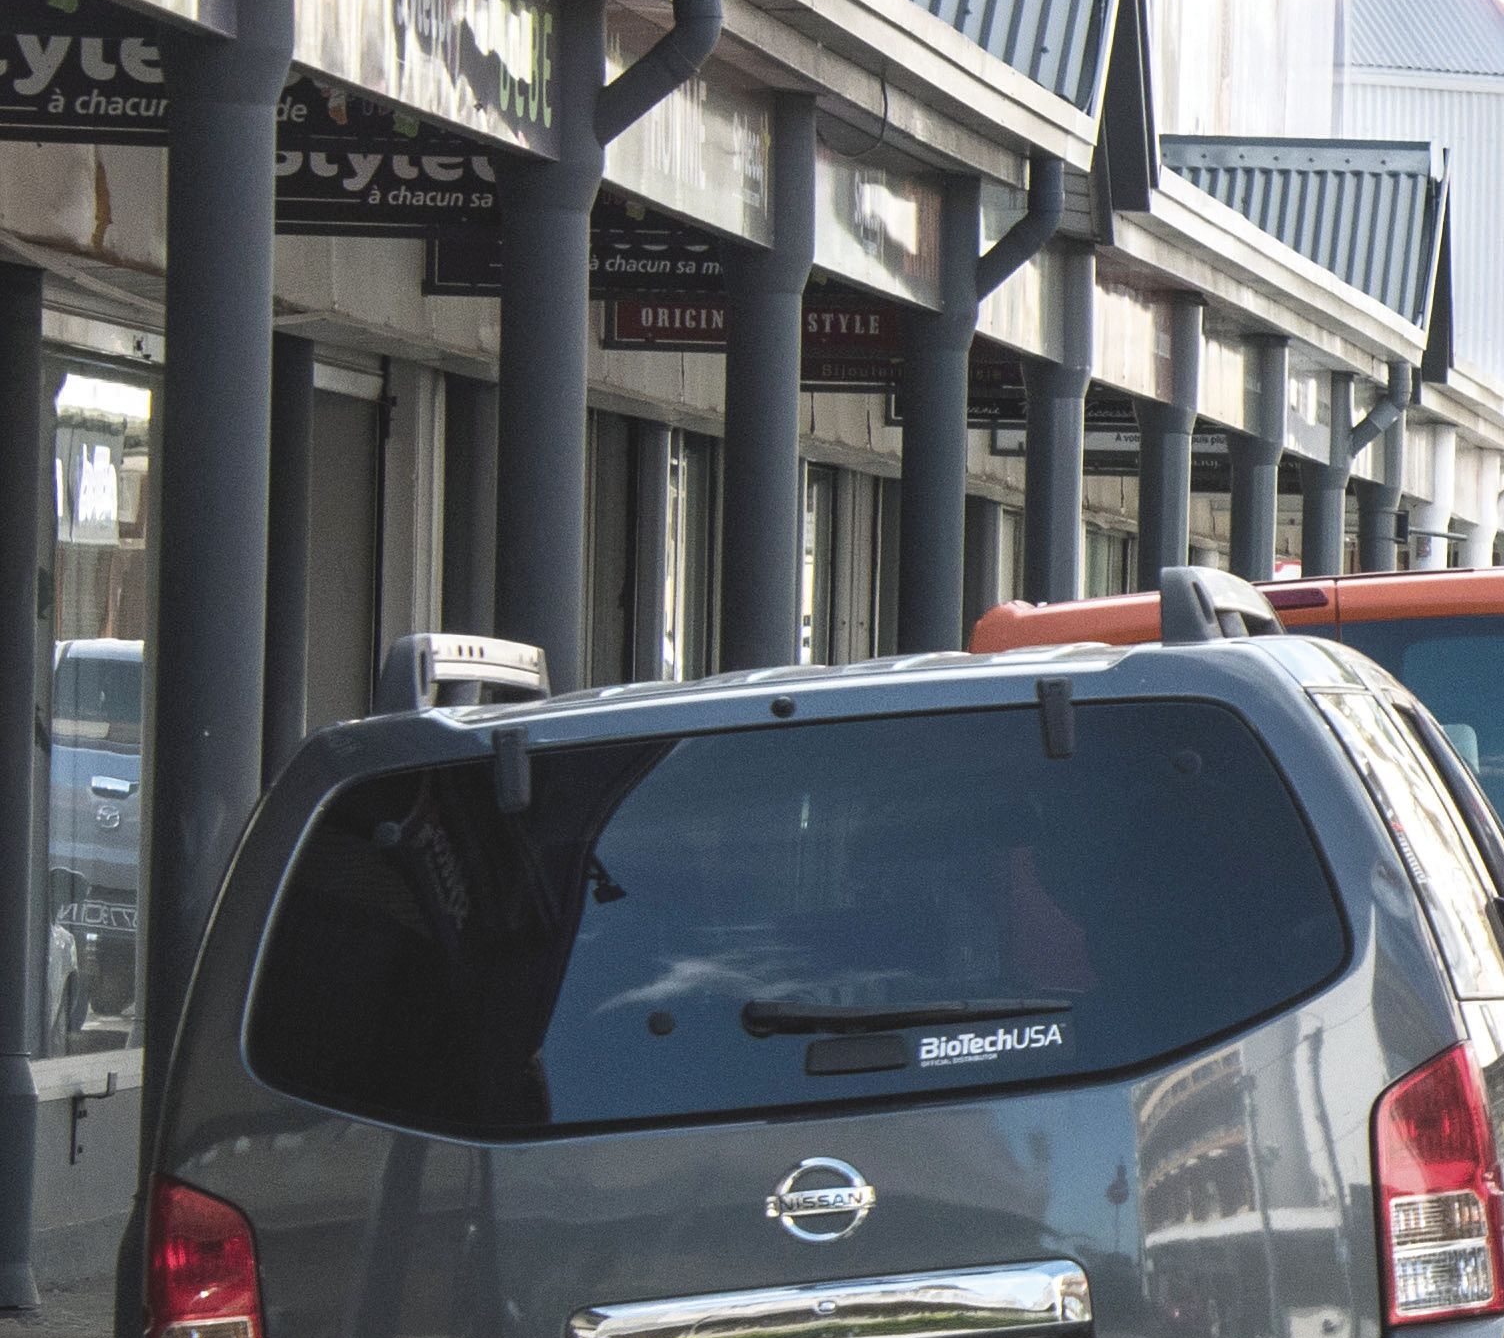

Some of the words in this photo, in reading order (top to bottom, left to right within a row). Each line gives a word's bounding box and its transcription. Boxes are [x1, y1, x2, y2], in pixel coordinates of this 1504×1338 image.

[388, 187, 464, 208] chacun
[808, 313, 880, 335] STYLE
[920, 1024, 1062, 1060] BioTechUSA
[778, 1191, 863, 1212] NISSAN
